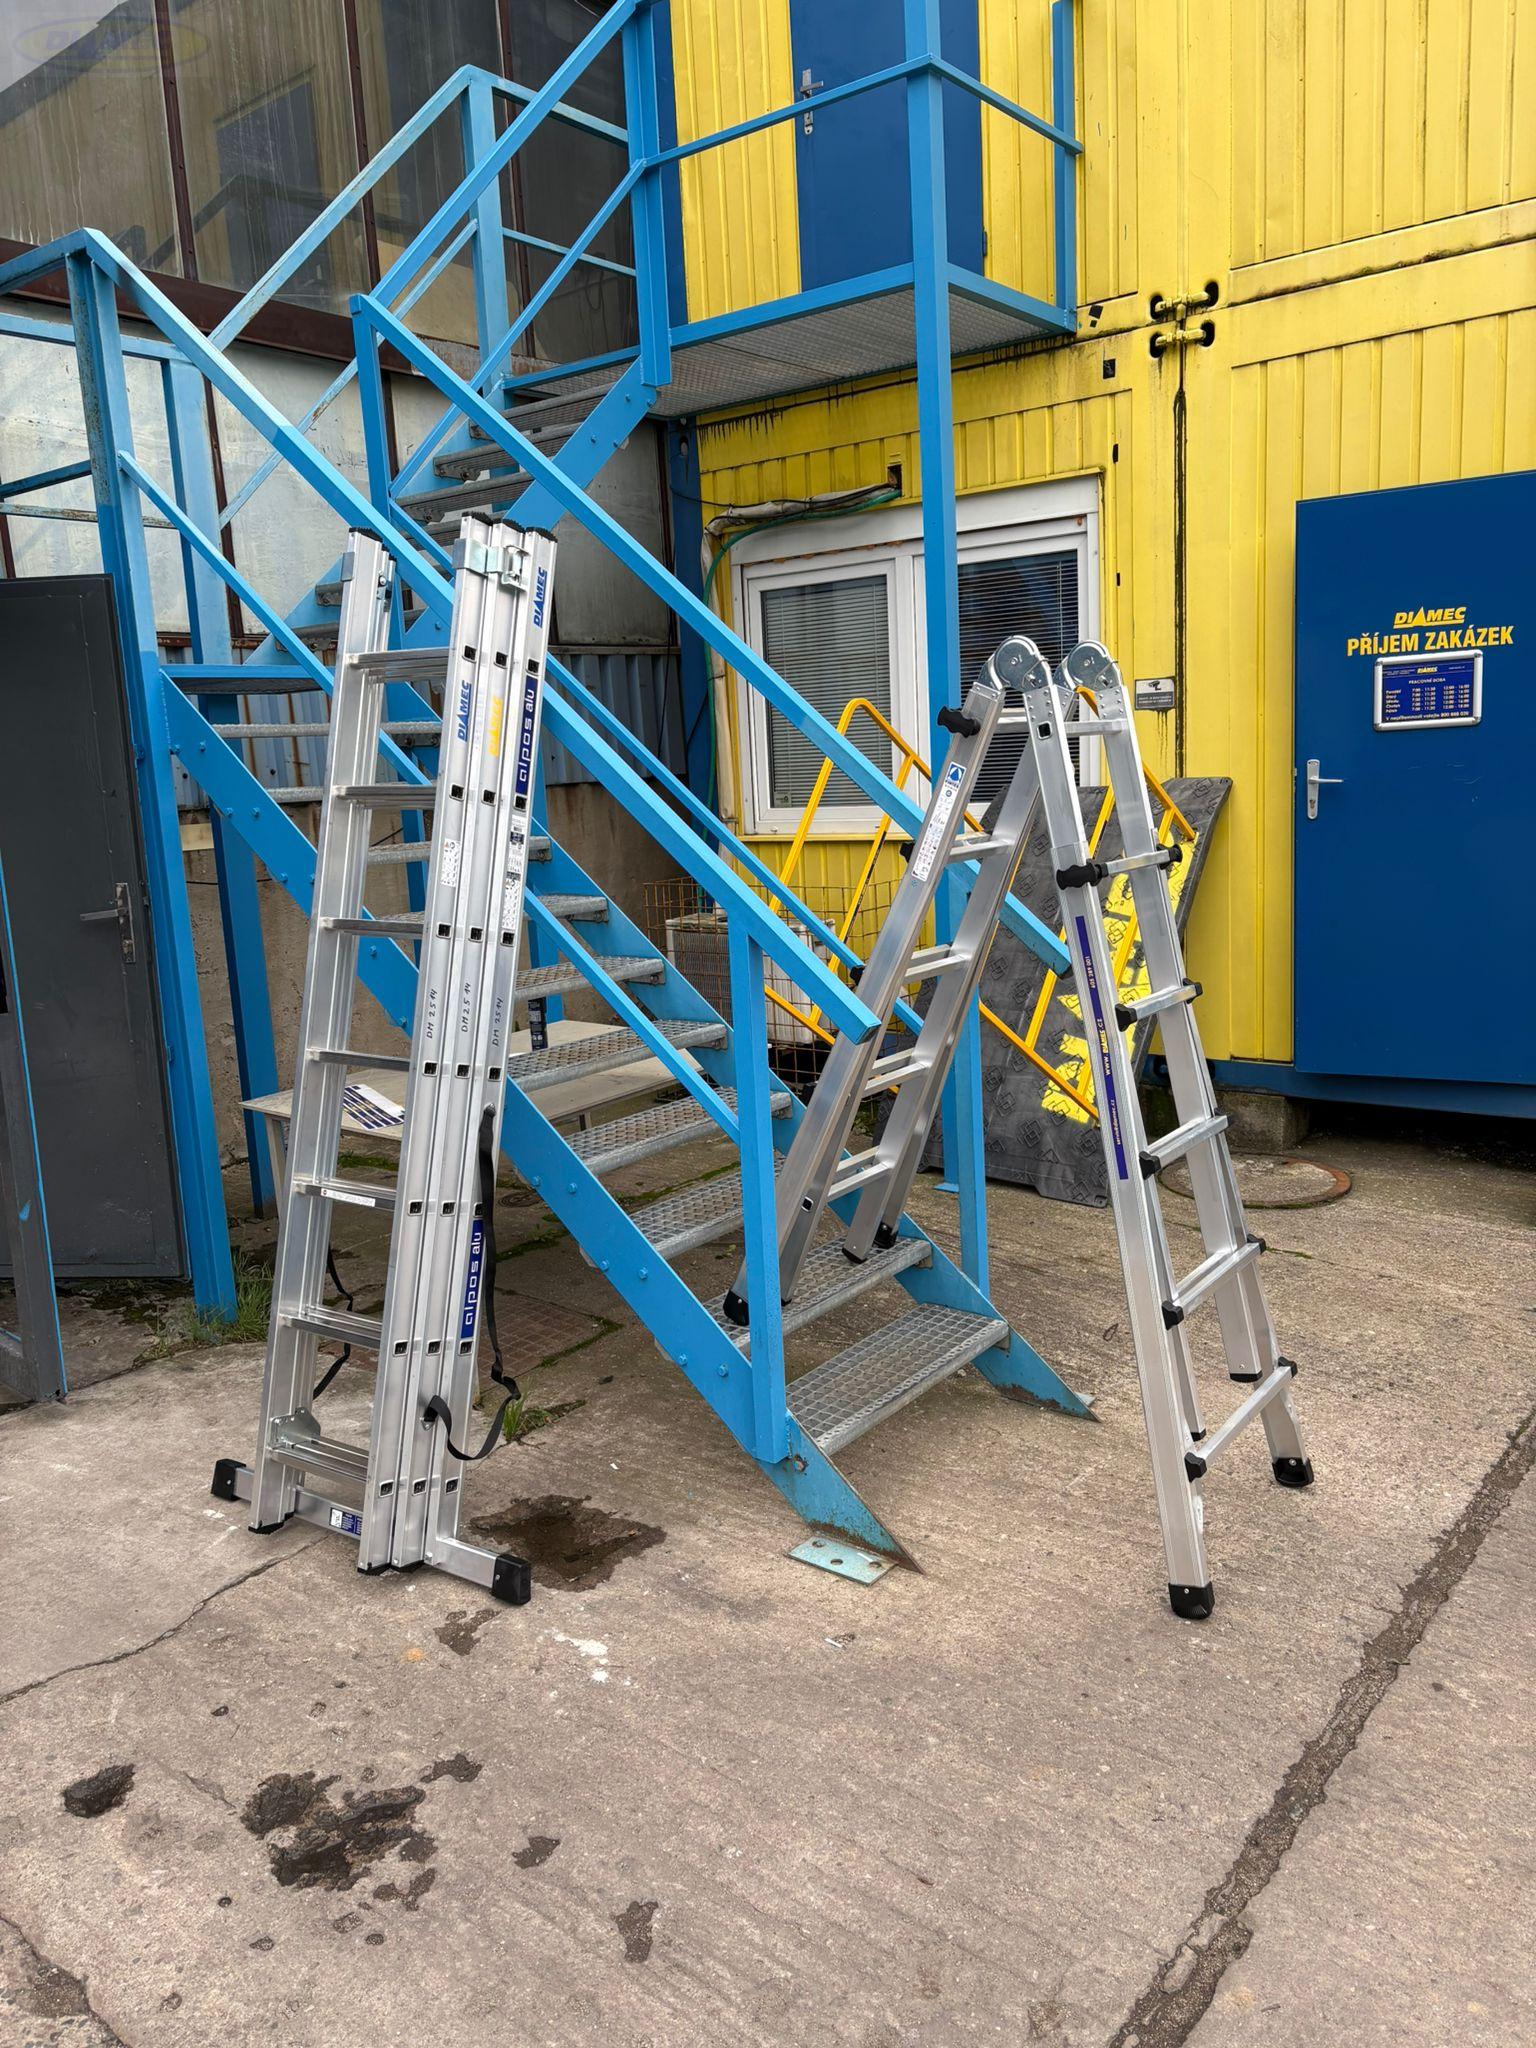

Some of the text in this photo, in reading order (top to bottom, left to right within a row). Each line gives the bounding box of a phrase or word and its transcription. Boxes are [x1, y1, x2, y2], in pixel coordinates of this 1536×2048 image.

[533, 566, 548, 629] DIAMEC
[1393, 606, 1467, 628] DIAMEC
[1347, 625, 1515, 656] PŘÍJEM ZAKÁZEK
[457, 679, 472, 742] DIAMEC
[519, 688, 536, 783] alpos alu
[426, 1022, 434, 1039] DM
[492, 1029, 500, 1047] DM
[464, 1232, 482, 1325] alpos alu
